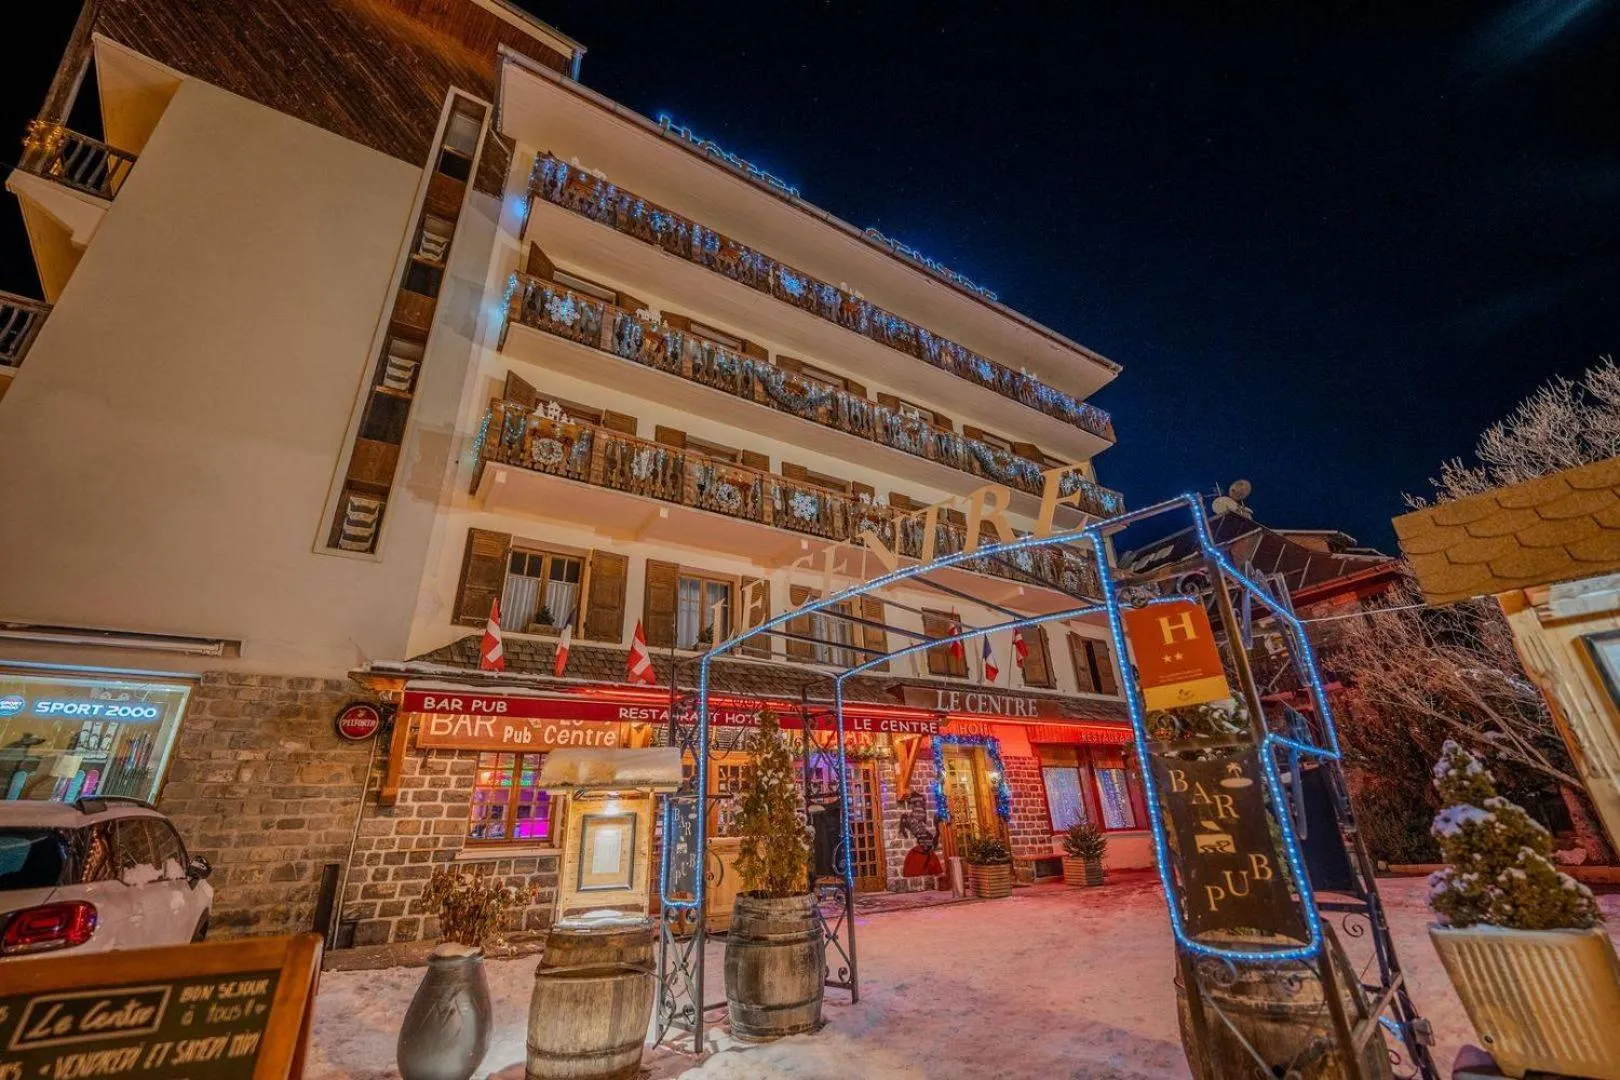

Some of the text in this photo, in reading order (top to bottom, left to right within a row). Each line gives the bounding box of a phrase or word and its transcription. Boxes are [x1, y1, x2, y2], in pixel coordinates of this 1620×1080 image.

[786, 460, 1092, 608] CENTRE
[1156, 611, 1199, 645] H
[35, 700, 103, 717] SPORT
[104, 704, 158, 719] 2000
[423, 697, 508, 713] BAR PUB
[618, 707, 762, 725] RESTARAT HOTE
[933, 689, 1039, 717] LE CENTRE
[429, 715, 497, 738] BAR
[502, 726, 617, 746] Pub Centre
[854, 719, 938, 734] LE CENTRE
[1168, 769, 1240, 819] BAR
[674, 807, 692, 836] BAR
[1206, 854, 1273, 912] PUB
[24, 1003, 74, 1039] Le
[79, 999, 156, 1031] Centre
